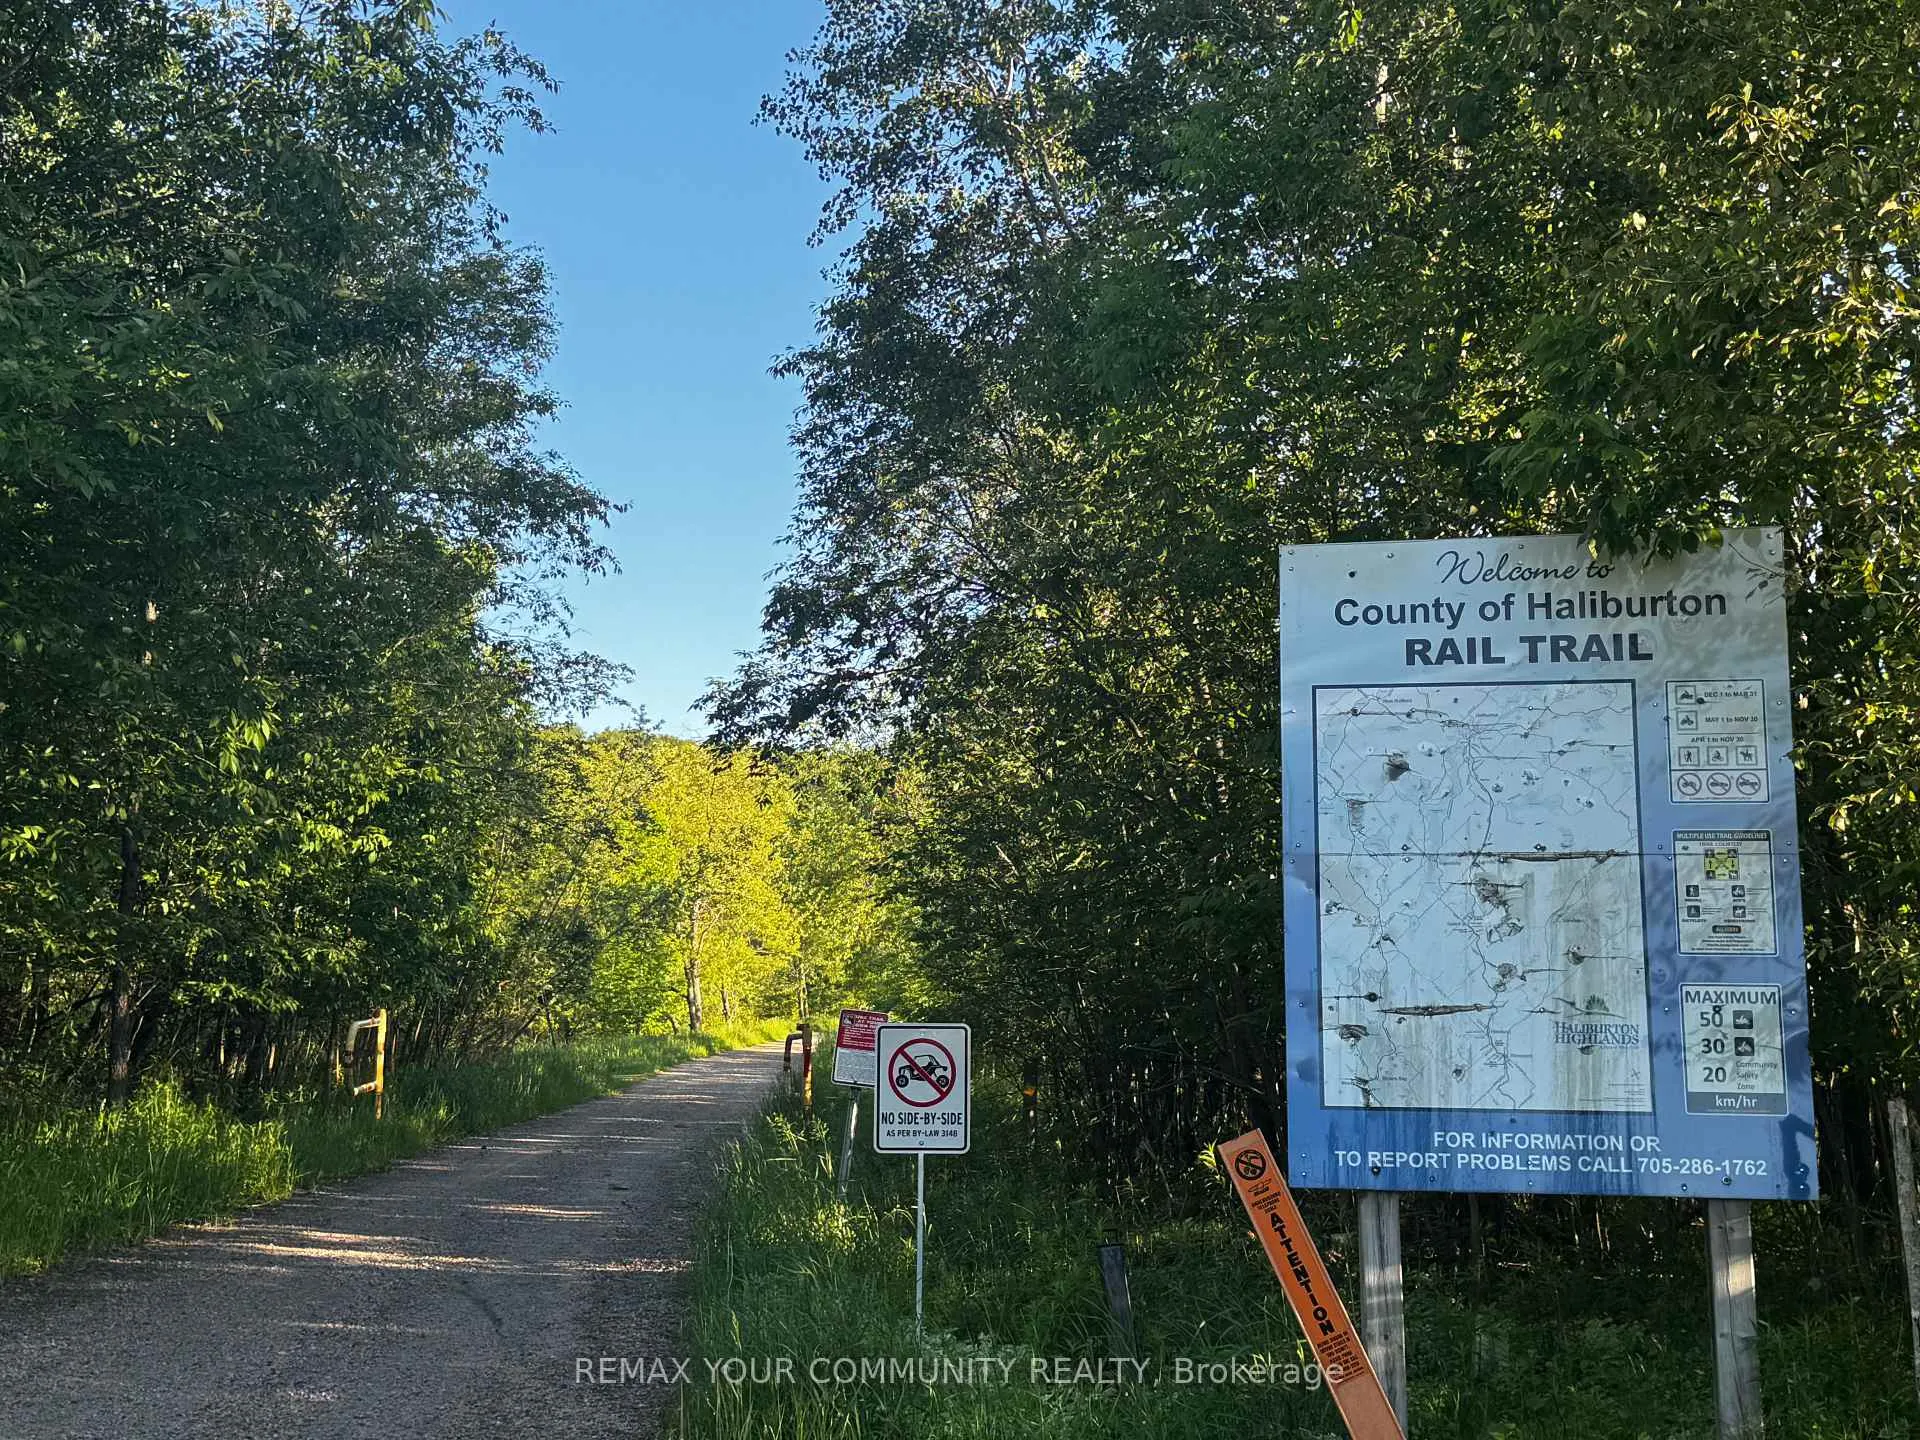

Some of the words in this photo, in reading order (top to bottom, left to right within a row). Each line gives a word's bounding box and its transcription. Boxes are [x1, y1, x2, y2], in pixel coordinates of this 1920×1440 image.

[1436, 550, 1581, 585] Welcome
[1586, 560, 1615, 579] to
[1334, 597, 1466, 630] County
[1478, 592, 1515, 622] of
[1527, 589, 1728, 621] Haliburton
[1405, 636, 1506, 666] RAIL
[1519, 632, 1653, 665] TRAIL
[1685, 990, 1777, 1005] MAXIMUM
[1700, 1011, 1724, 1028] 50
[1555, 1022, 1640, 1035] HALIBURTON
[1555, 1033, 1640, 1045] HIGHLANDS
[1701, 1038, 1725, 1054] 30
[1735, 1061, 1778, 1070] Community
[1703, 1066, 1727, 1083] 20
[1715, 1095, 1758, 1109] km/hr
[881, 1111, 895, 1125] NO
[897, 1111, 964, 1126] SIDE-BY-SIDE
[886, 1129, 897, 1137] AS
[897, 1129, 911, 1137] PER
[912, 1129, 940, 1137] BY-LAW
[1434, 1131, 1476, 1149] FOR
[1482, 1132, 1624, 1152] INFORMATION
[1630, 1136, 1661, 1152] OR
[1334, 1150, 1362, 1167] TO
[1367, 1151, 1451, 1169] REPORT
[1457, 1153, 1571, 1172] PROBLEMS
[1578, 1156, 1633, 1174] CALL
[1638, 1157, 1769, 1176] 705-286-1762
[1269, 1212, 1335, 1337] ATTENTION
